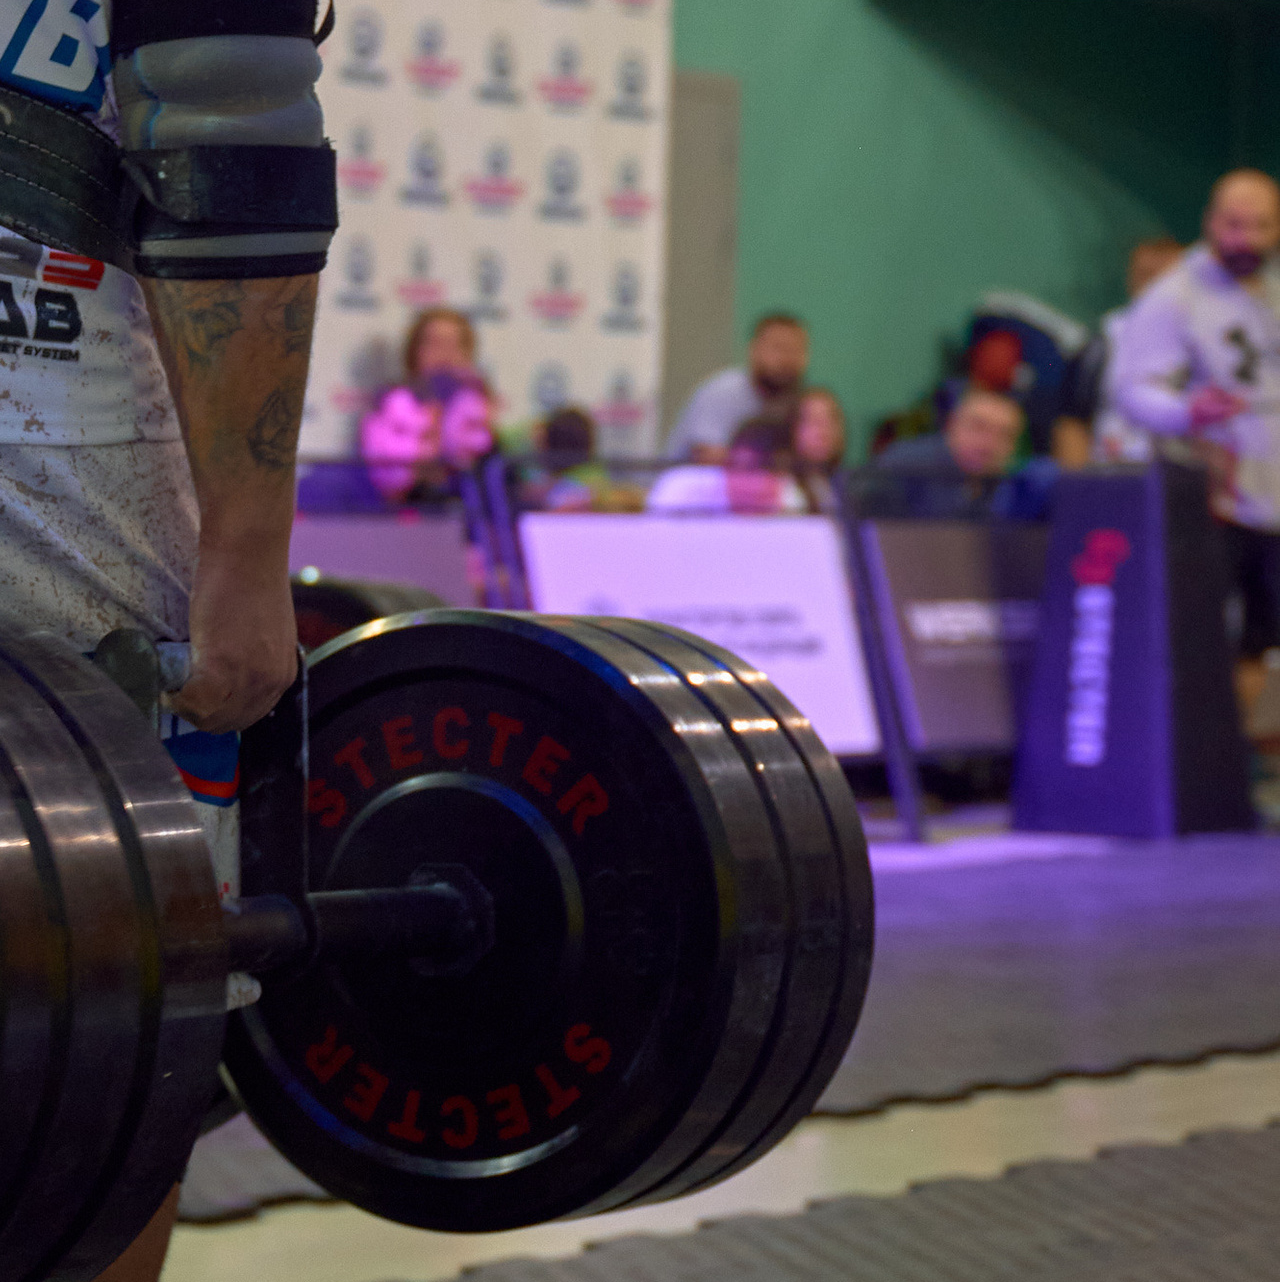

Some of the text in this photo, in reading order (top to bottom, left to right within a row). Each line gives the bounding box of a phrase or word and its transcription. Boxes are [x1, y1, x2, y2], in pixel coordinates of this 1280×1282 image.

[23, 344, 80, 363] SYSTEM
[306, 707, 609, 836] STECTER
[304, 1023, 613, 1149] STECTER
